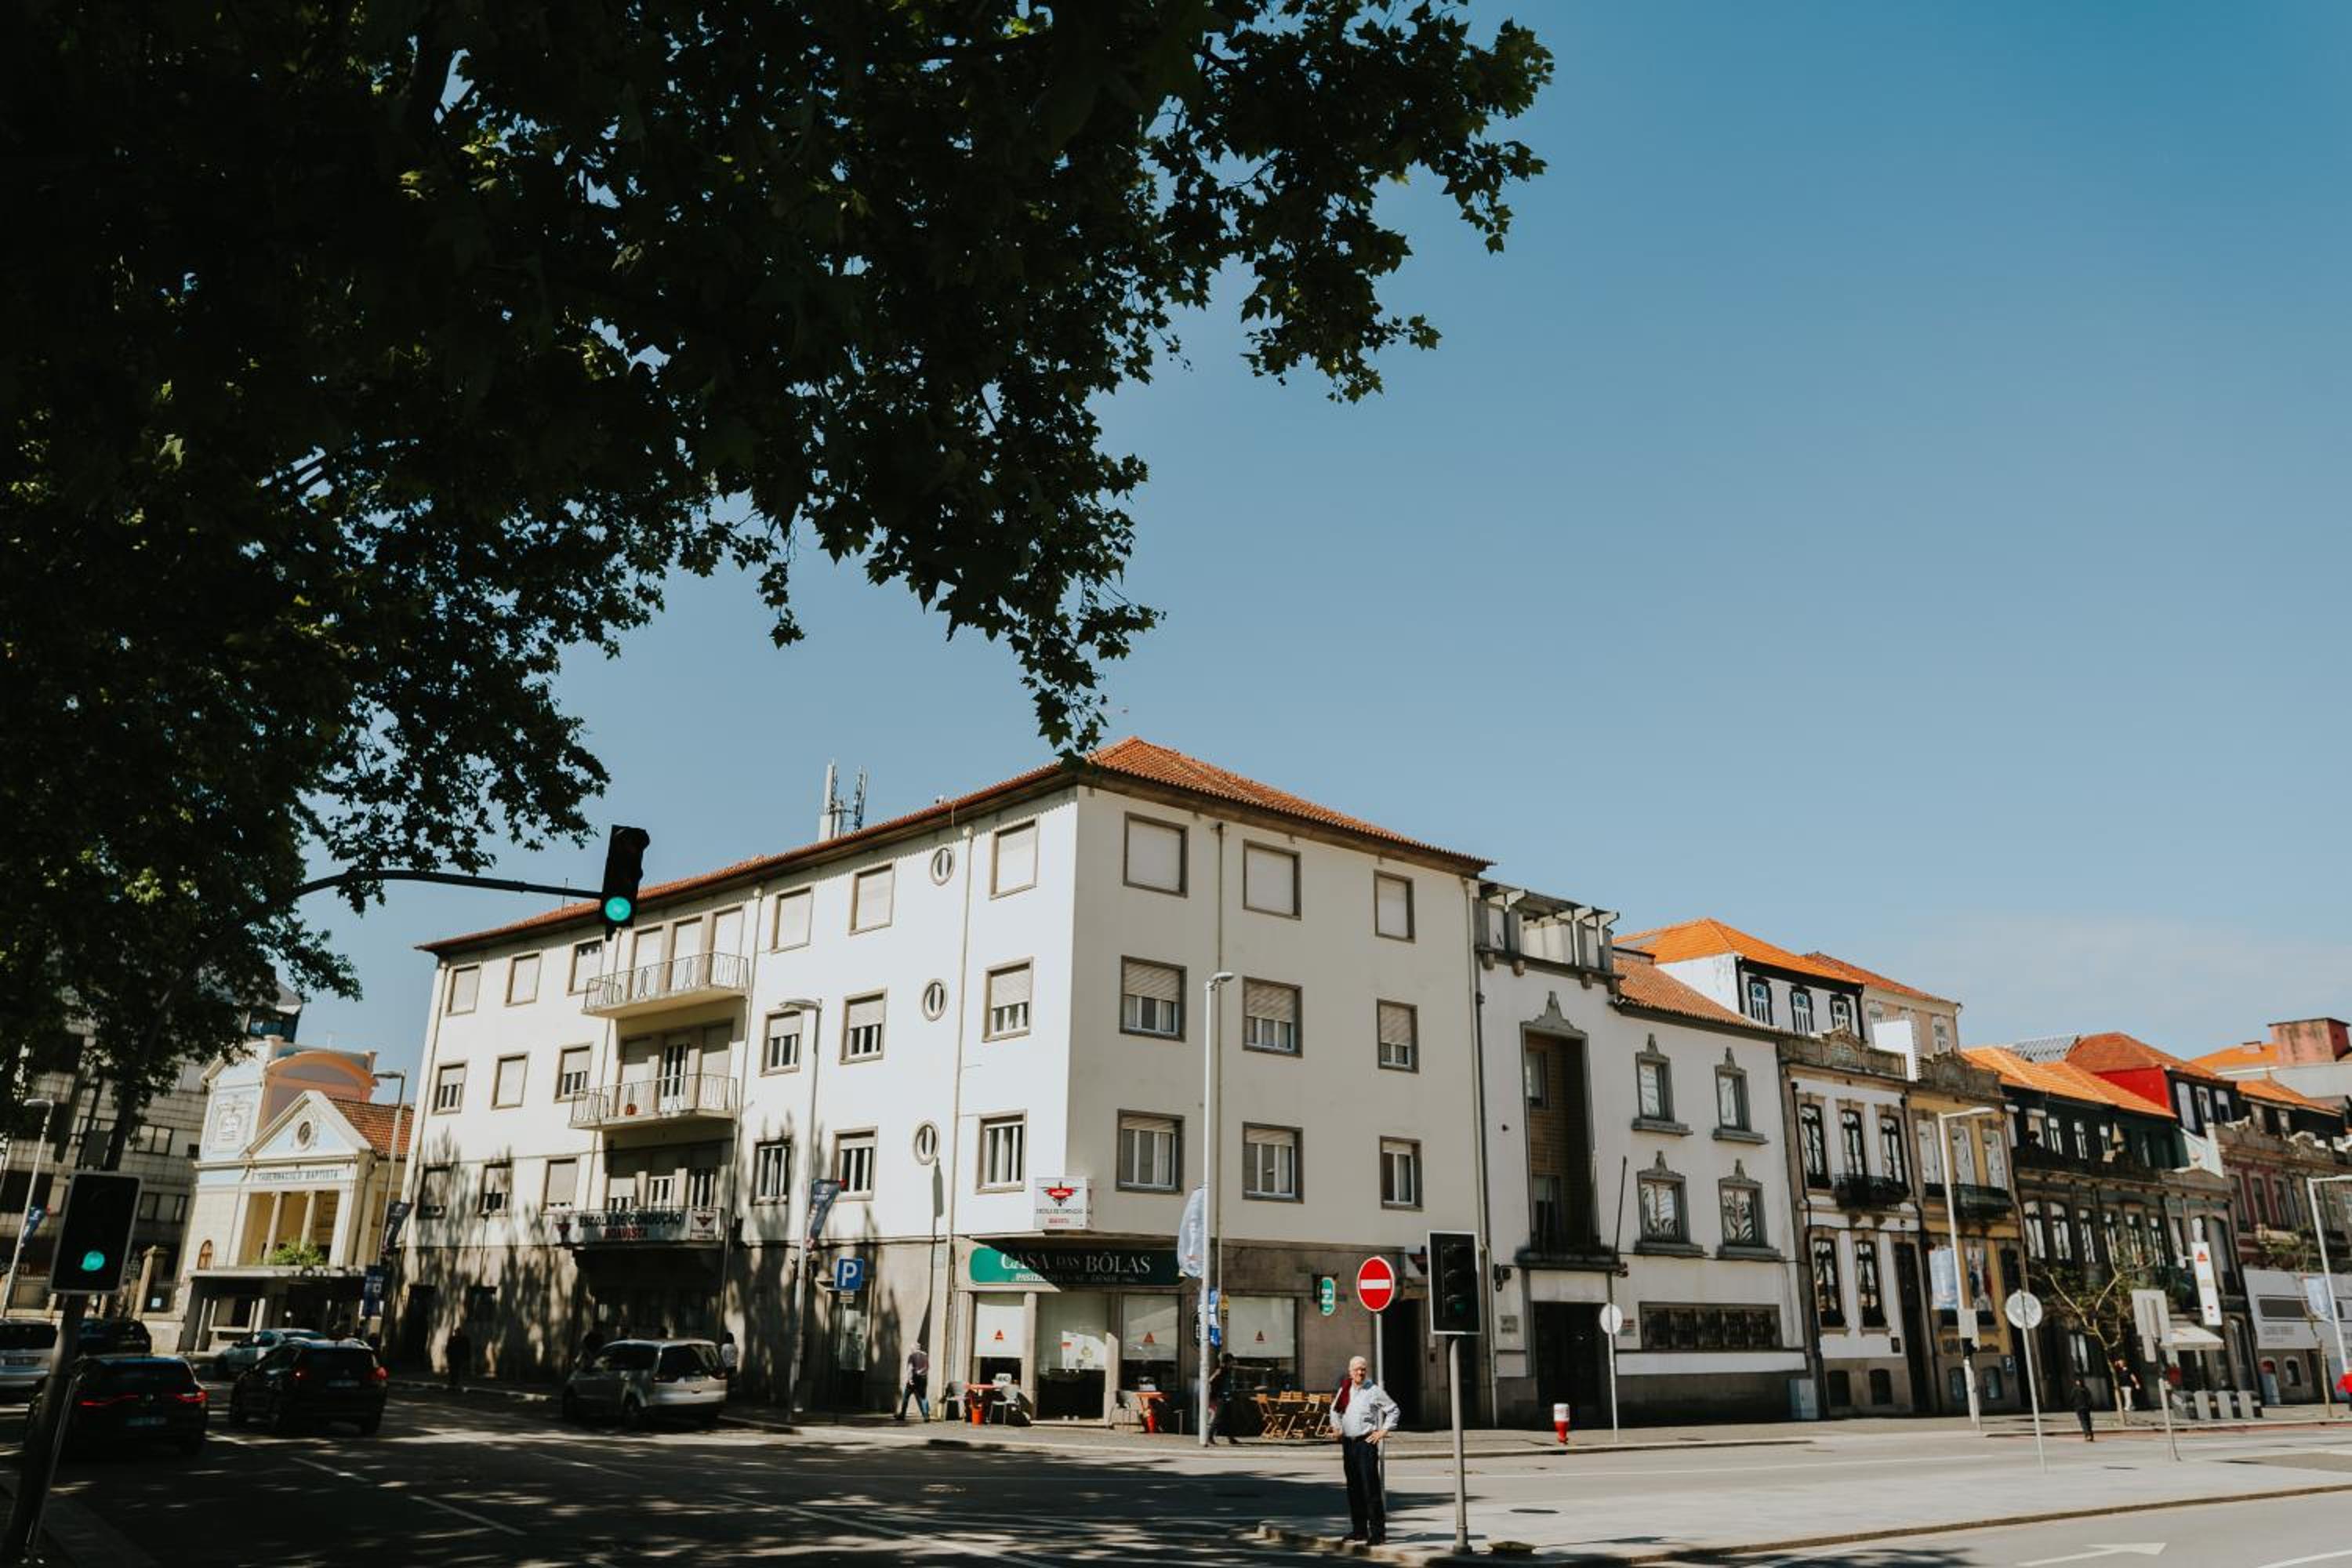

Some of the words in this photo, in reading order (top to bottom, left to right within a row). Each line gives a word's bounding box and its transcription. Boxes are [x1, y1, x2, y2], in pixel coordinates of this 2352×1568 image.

[841, 1261, 858, 1287] P
[1000, 1252, 1051, 1269] CASA
[1085, 1251, 1151, 1274] BÔLAS
